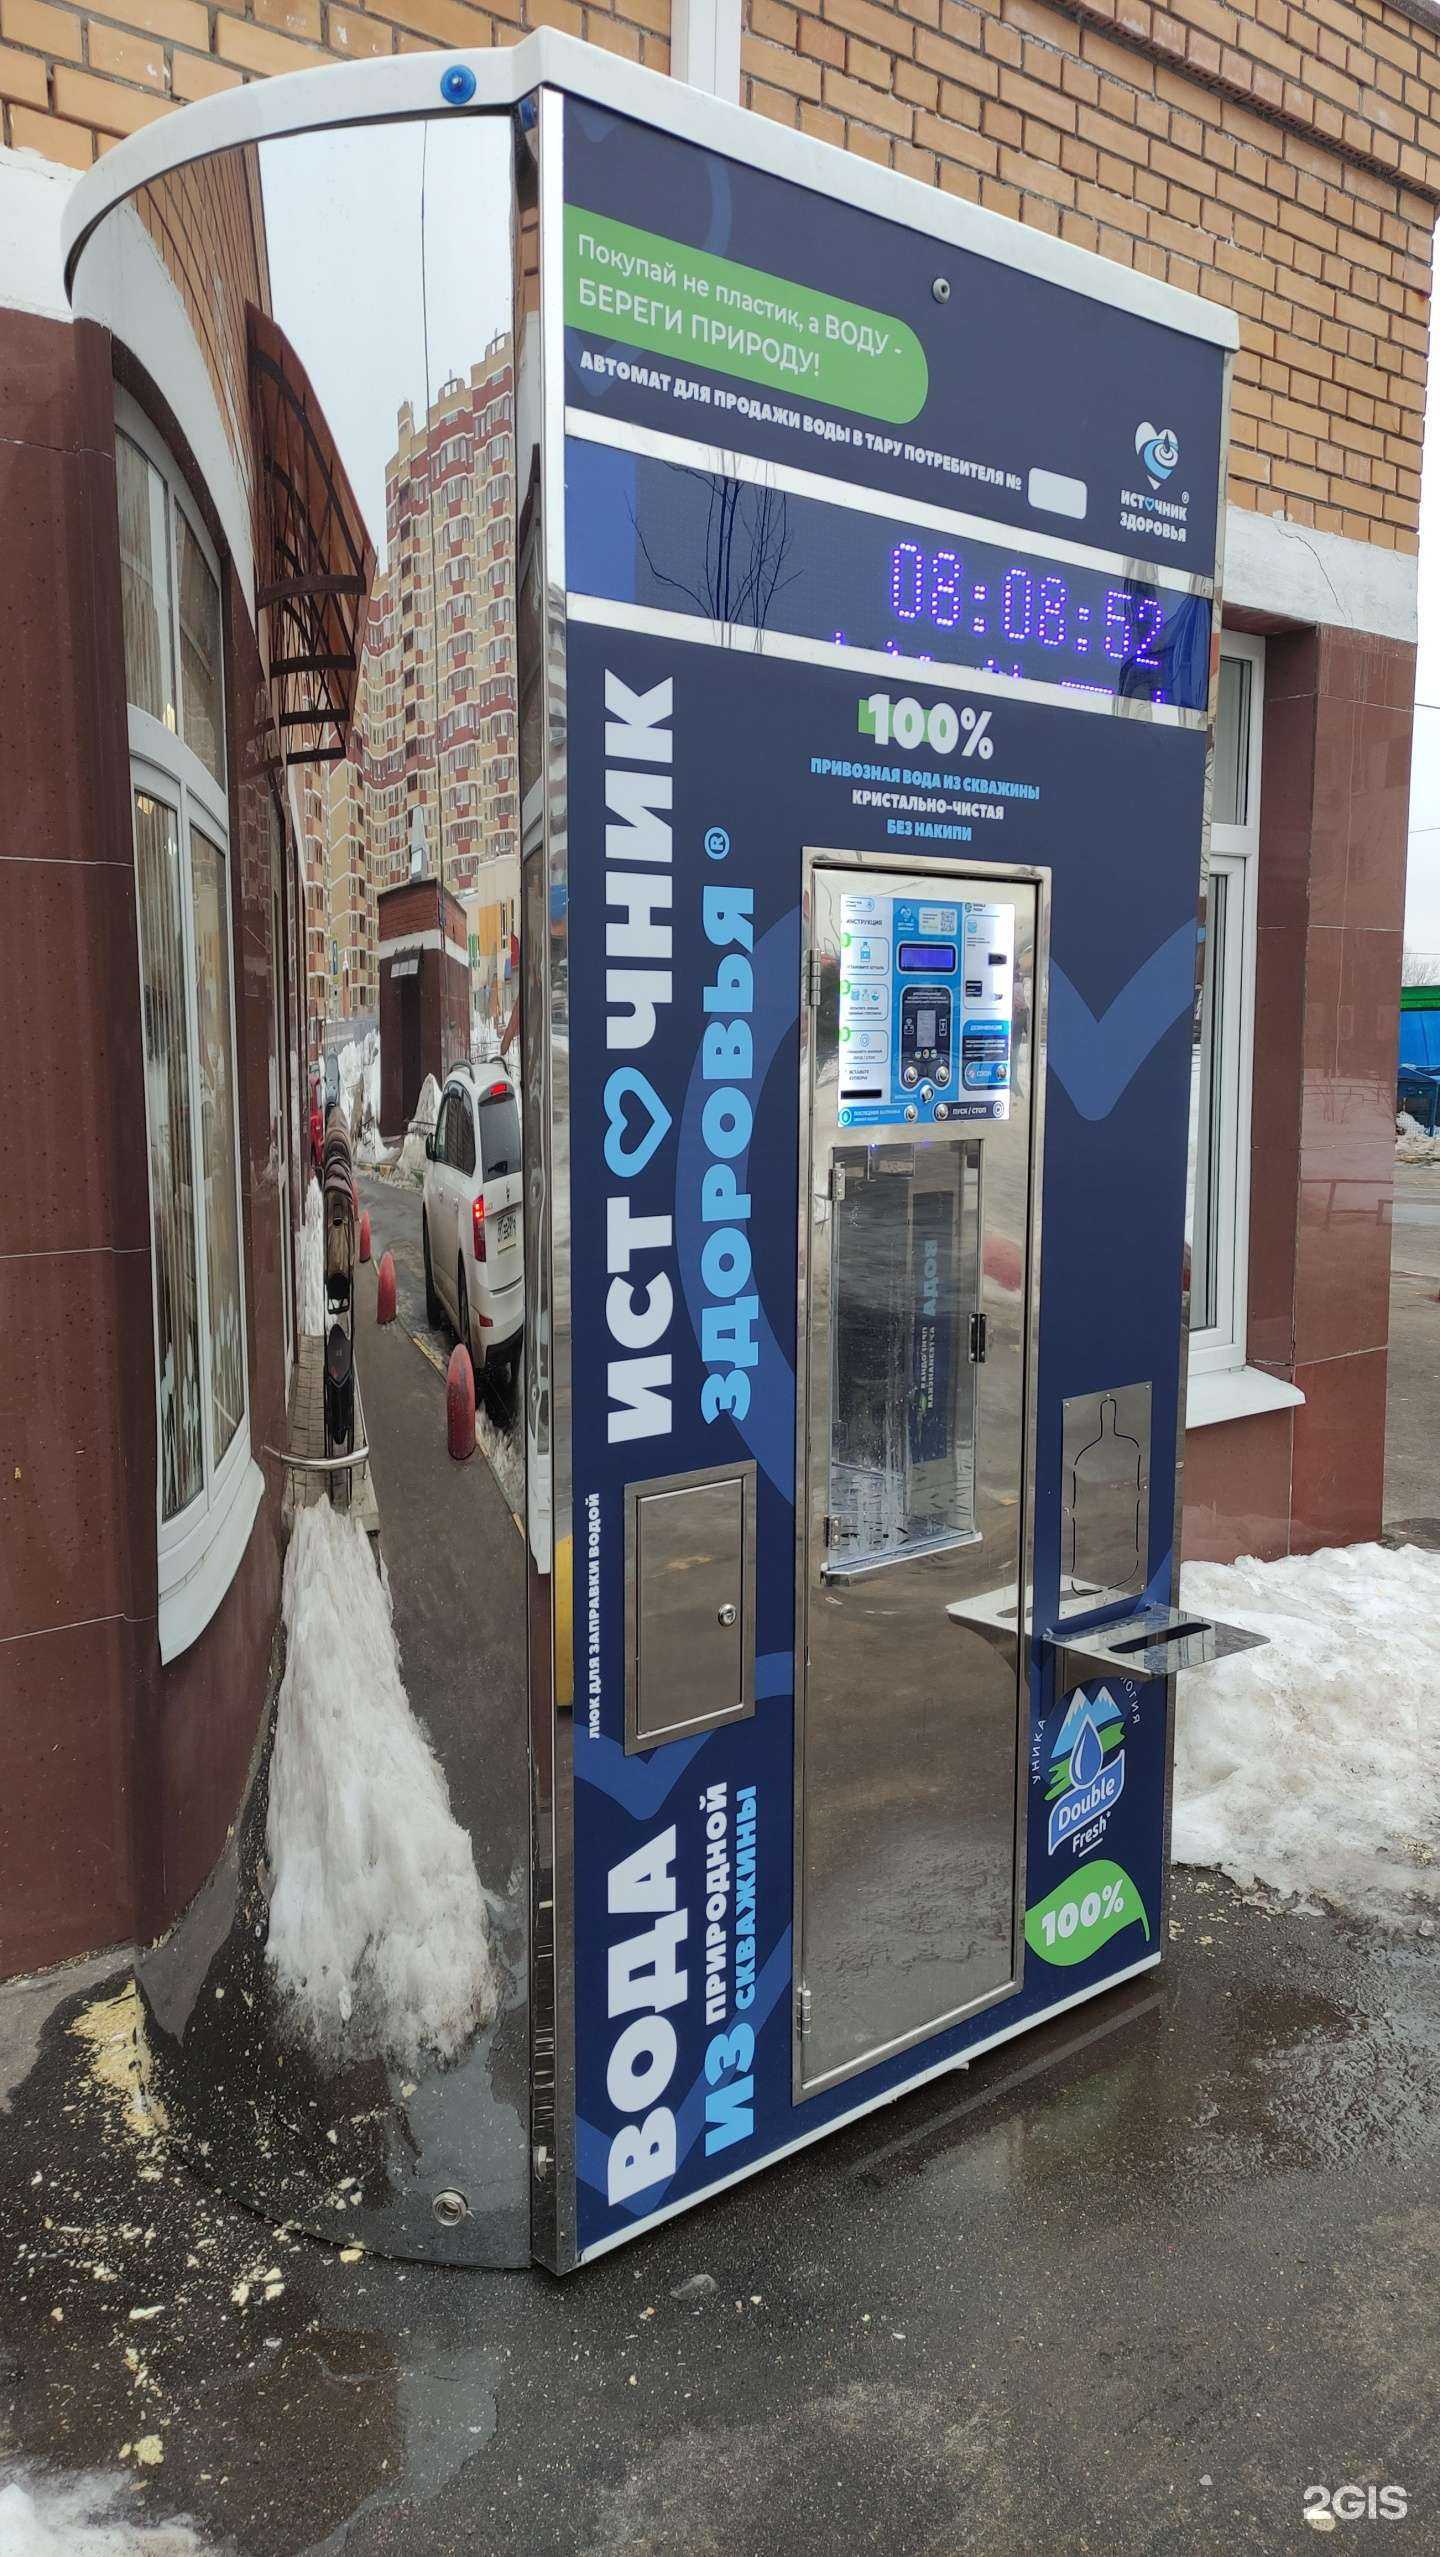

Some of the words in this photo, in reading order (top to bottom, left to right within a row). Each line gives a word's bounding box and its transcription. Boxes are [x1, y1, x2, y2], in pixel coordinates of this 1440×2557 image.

[577, 233, 676, 287] Покупай
[684, 274, 709, 296] не
[716, 285, 803, 334] пластик,
[809, 318, 819, 334] а
[825, 314, 889, 357] ВОДУ
[578, 278, 683, 335] БЕРЕГИ
[691, 313, 820, 377] ПРИРОДУ!
[580, 350, 672, 392] АВТОМАТ
[673, 377, 711, 405] ДЛЯ
[714, 389, 801, 430] ПРОДАЖИ
[803, 415, 850, 443] ВОДЫ
[852, 429, 864, 446] В
[865, 432, 903, 457] ТАРУ
[904, 444, 1004, 485] ПОТРЕБИТЕЛЯ
[1006, 473, 1022, 491] №
[1120, 511, 1187, 543] ЗДОРОВЬЯ
[892, 542, 1163, 666] 08:08:52
[867, 693, 994, 760] 100%
[810, 757, 901, 784] ПРИВОЗНАЯ
[902, 769, 941, 789] ВОДА
[943, 775, 962, 791] ИЗ
[963, 777, 1041, 800] СКВАЖИНЫ
[852, 789, 1005, 820] КРИСТАЛЬНО-ЧИСТАЯ
[887, 819, 913, 836] БЕЗ
[914, 822, 973, 842] НАКИПИ
[701, 885, 759, 1425] ЗДОРОВЬЯ
[584, 1492, 602, 1559] ВОДОЙ
[588, 1559, 601, 1656] ЗАПРАВКИ
[588, 1656, 602, 1694] ДЛЯ
[589, 1696, 601, 1739] ЛЮК
[1058, 1776, 1116, 1832] Double
[699, 1782, 730, 2026] ПРИРОДНОЙ
[734, 1785, 758, 2011] СКВАЖИНЫ
[1041, 1878, 1125, 1947] 100%
[606, 1823, 688, 2207] ВОДА
[704, 2021, 756, 2158] ИЗ
